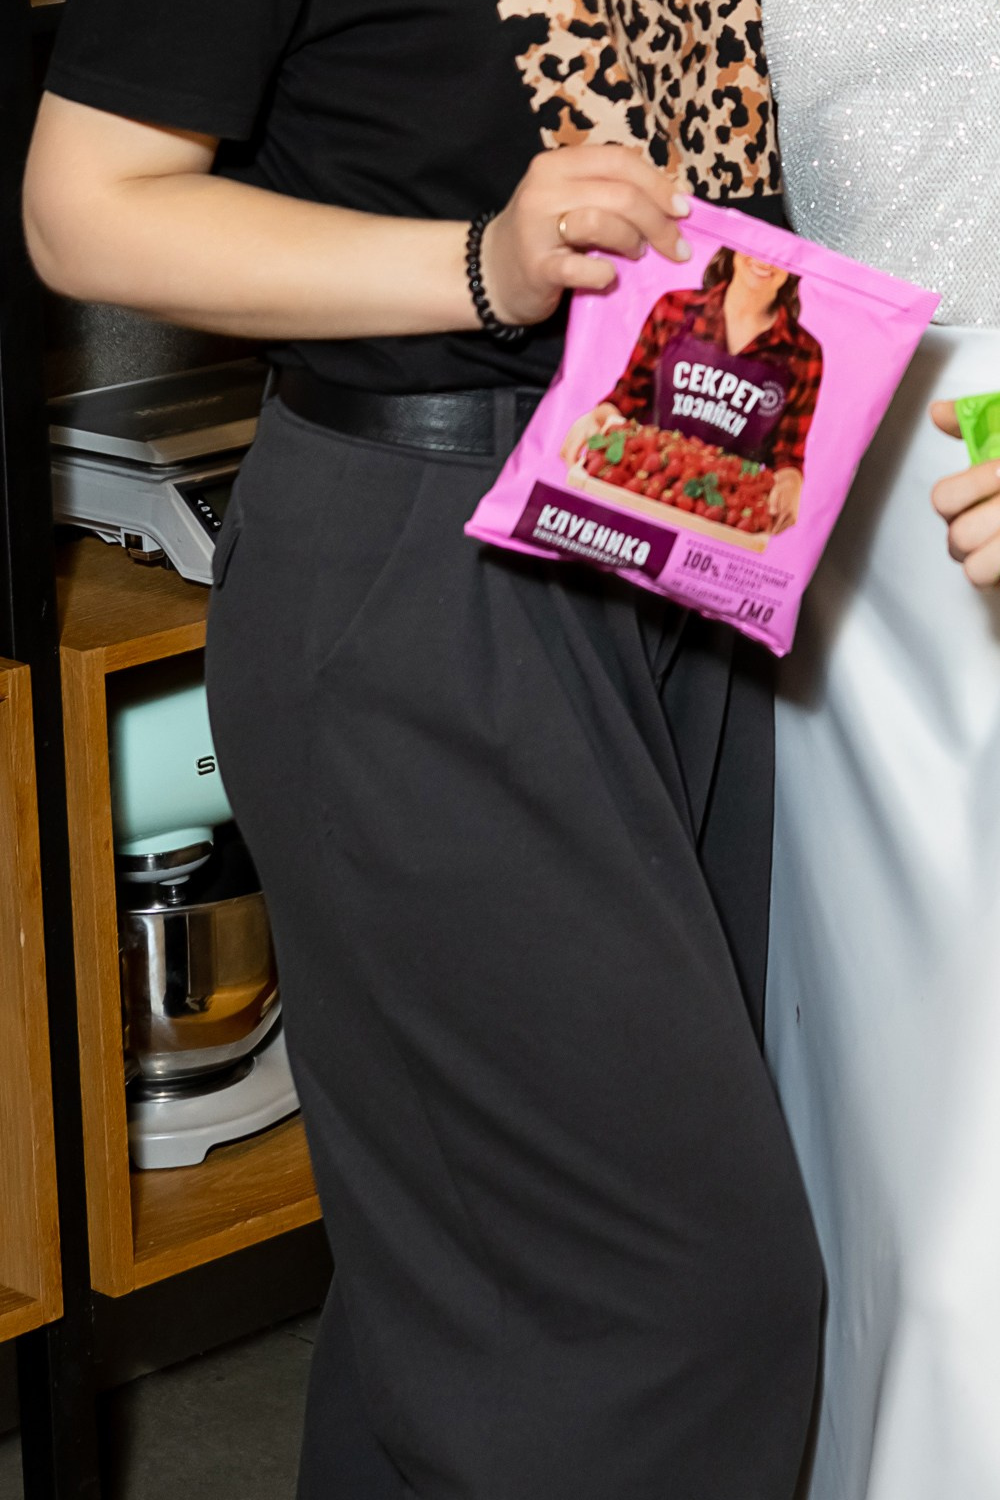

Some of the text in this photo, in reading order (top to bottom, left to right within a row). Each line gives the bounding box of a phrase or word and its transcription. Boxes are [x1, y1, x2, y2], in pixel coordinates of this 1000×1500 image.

[673, 361, 766, 414] СЕКРЕТ
[672, 393, 748, 437] ХОЗЯЙКИ
[683, 549, 719, 577] 100%
[737, 598, 774, 623] ГМО
